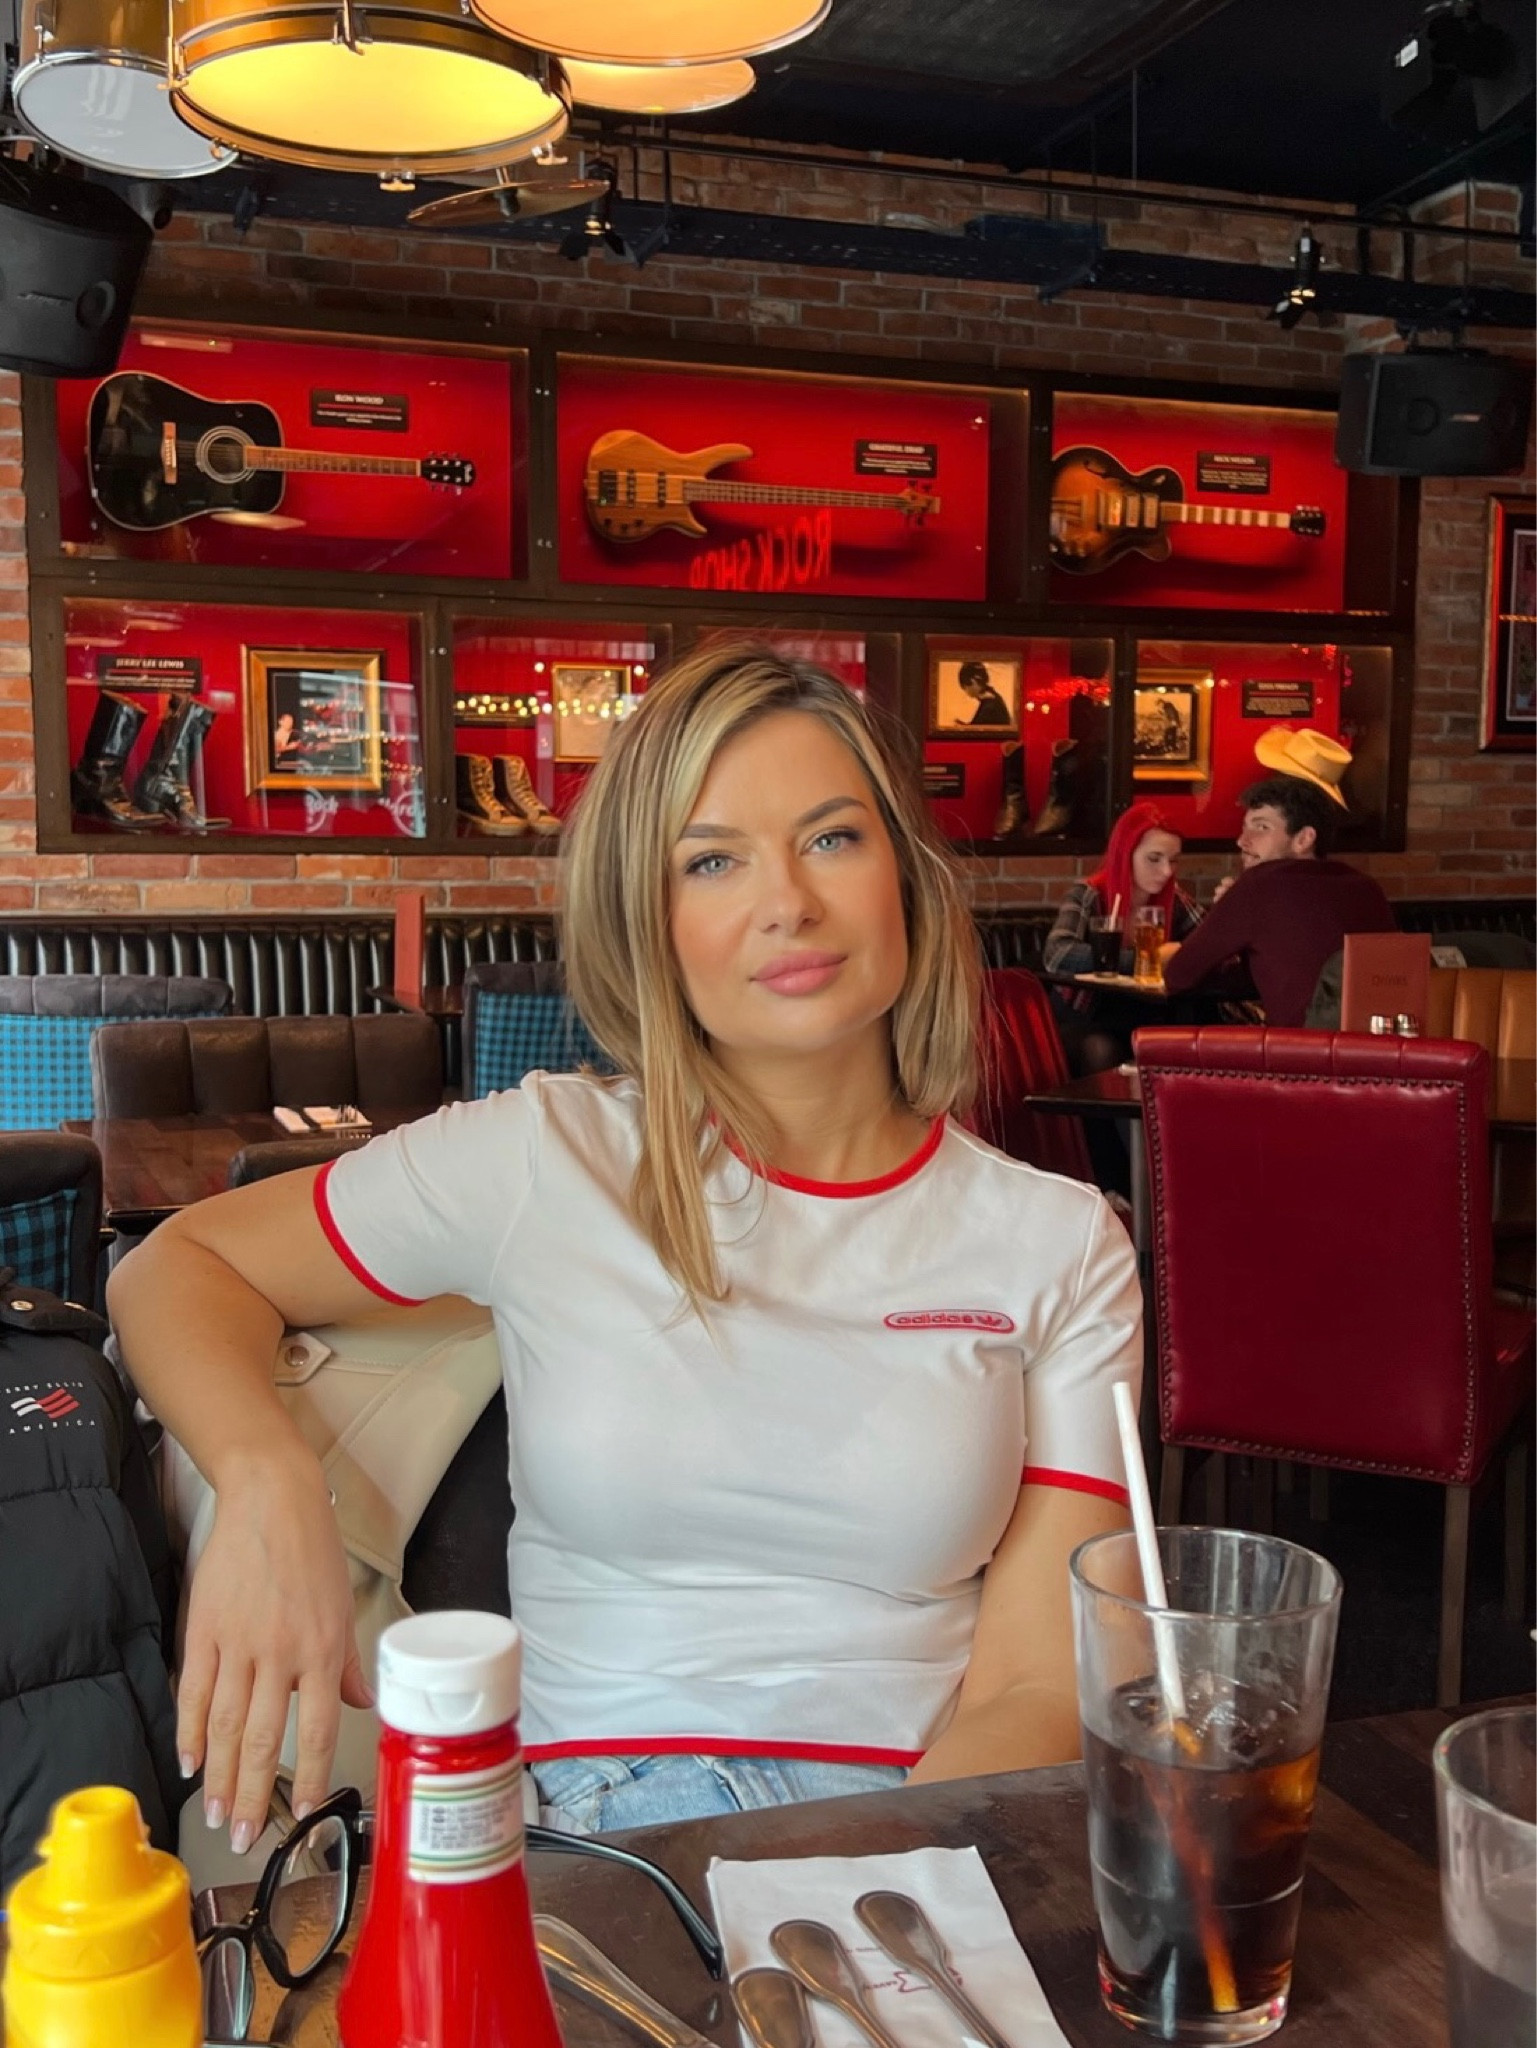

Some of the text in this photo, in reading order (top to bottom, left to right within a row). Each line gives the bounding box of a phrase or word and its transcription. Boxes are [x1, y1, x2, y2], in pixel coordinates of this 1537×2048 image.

[116, 658, 185, 669] JERRY LEE LEWIS
[897, 1313, 973, 1324] adidas
[10, 1420, 95, 1434] AMERICA
